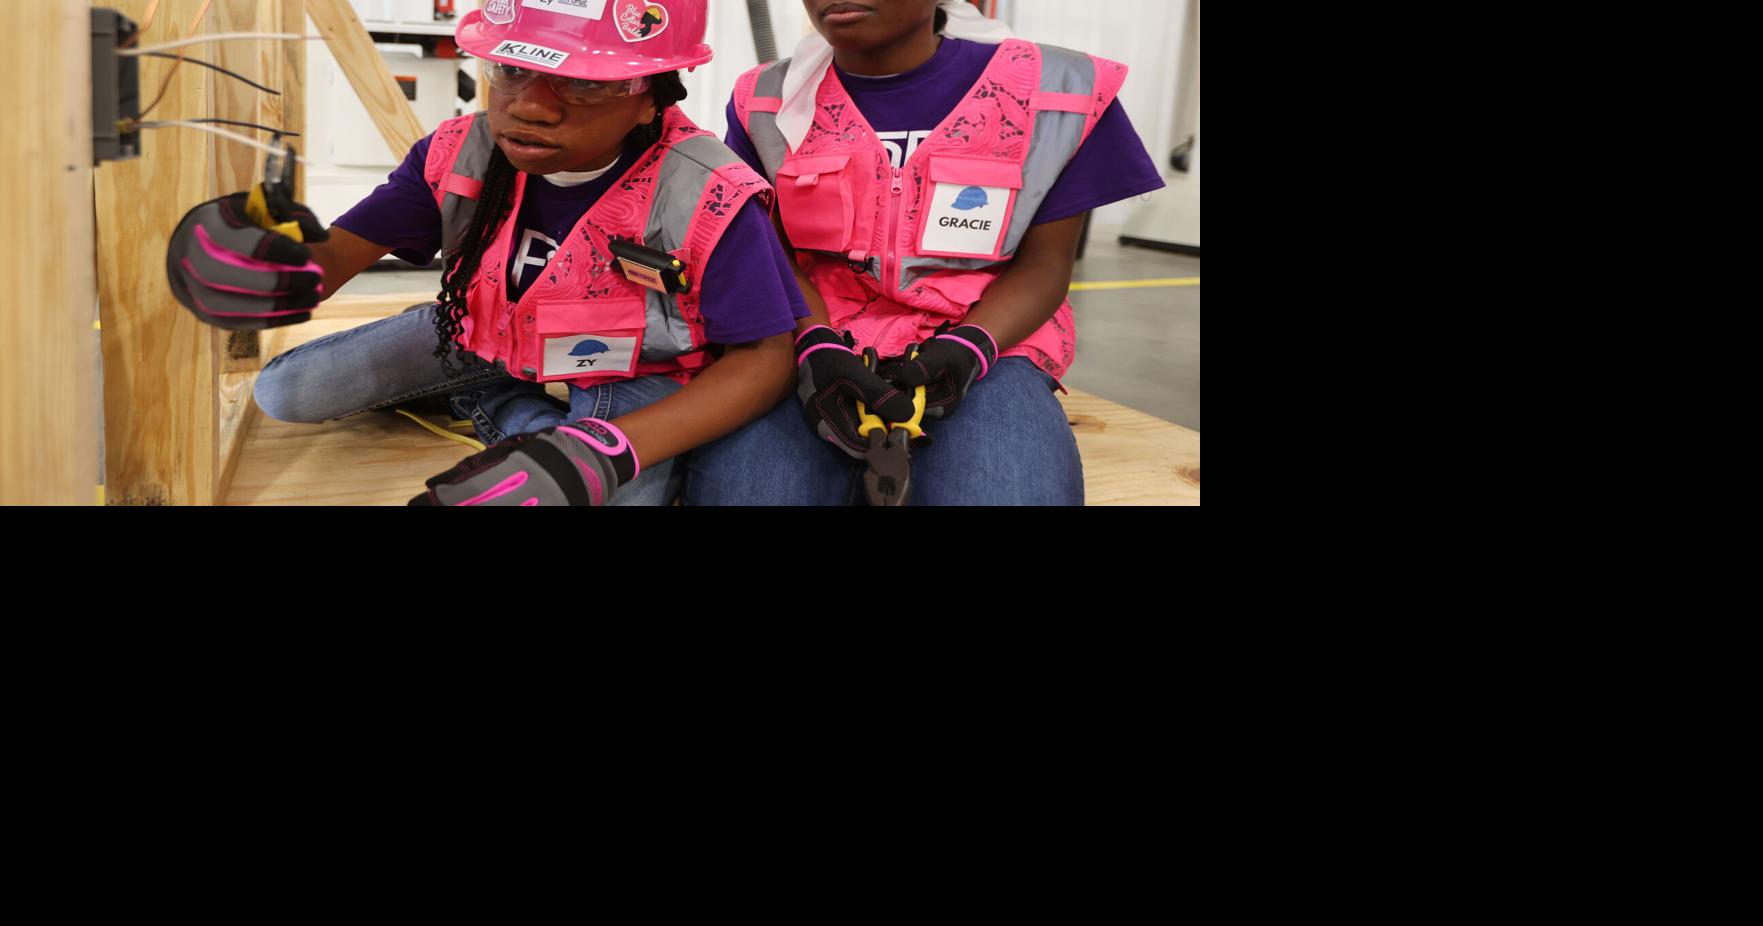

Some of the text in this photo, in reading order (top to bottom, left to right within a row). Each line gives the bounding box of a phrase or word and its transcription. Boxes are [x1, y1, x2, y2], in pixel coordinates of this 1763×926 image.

[487, 3, 513, 16] SAFETY
[625, 4, 641, 17] Blue
[620, 12, 640, 27] Collar
[499, 42, 564, 62] KLINE
[938, 216, 992, 231] GRACIE
[576, 358, 597, 368] ZY
